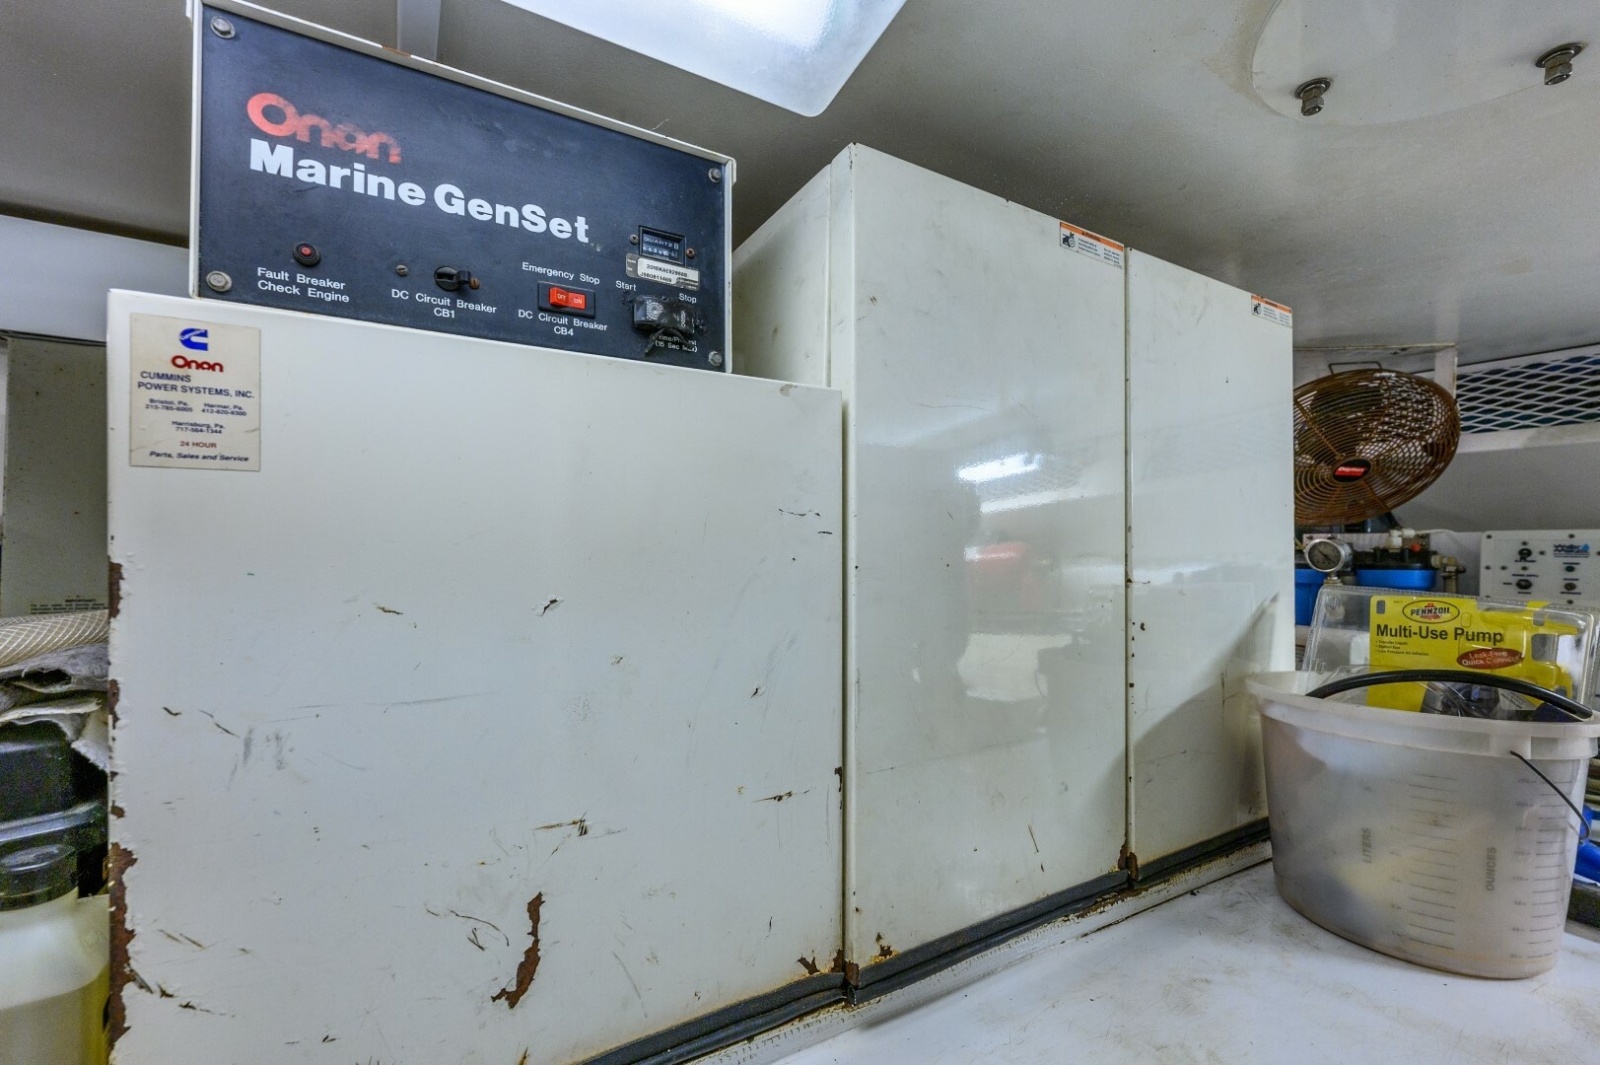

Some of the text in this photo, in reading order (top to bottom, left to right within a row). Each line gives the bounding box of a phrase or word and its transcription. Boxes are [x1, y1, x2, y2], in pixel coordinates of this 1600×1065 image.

[247, 92, 401, 164] Onan
[250, 138, 589, 243] Marine GenSet
[257, 267, 346, 290] Fault Breaker
[522, 262, 600, 285] Emergency Stop
[257, 280, 350, 303] Check Engine
[615, 280, 637, 291] Start
[391, 289, 497, 314] DC Circuit Breaker
[679, 293, 697, 304] Stop
[433, 307, 455, 318] CB1
[518, 309, 608, 331] DC Circuit Breaker
[554, 326, 574, 336] CB4
[667, 342, 680, 350] Sec
[171, 355, 224, 372] Onan
[140, 371, 192, 383] CUMMINS
[137, 381, 255, 398] POWER SYSTEMS, INC.
[191, 441, 217, 449] HOUR
[149, 450, 174, 459] Parts,
[176, 452, 200, 460] Sales
[219, 454, 249, 462] Service
[1410, 606, 1450, 616] PENNZOIL
[1376, 623, 1504, 645] Multi-Use Pump
[1462, 658, 1486, 666] Quick
[1361, 827, 1372, 864] LITERS
[1485, 846, 1497, 891] OUNCES
